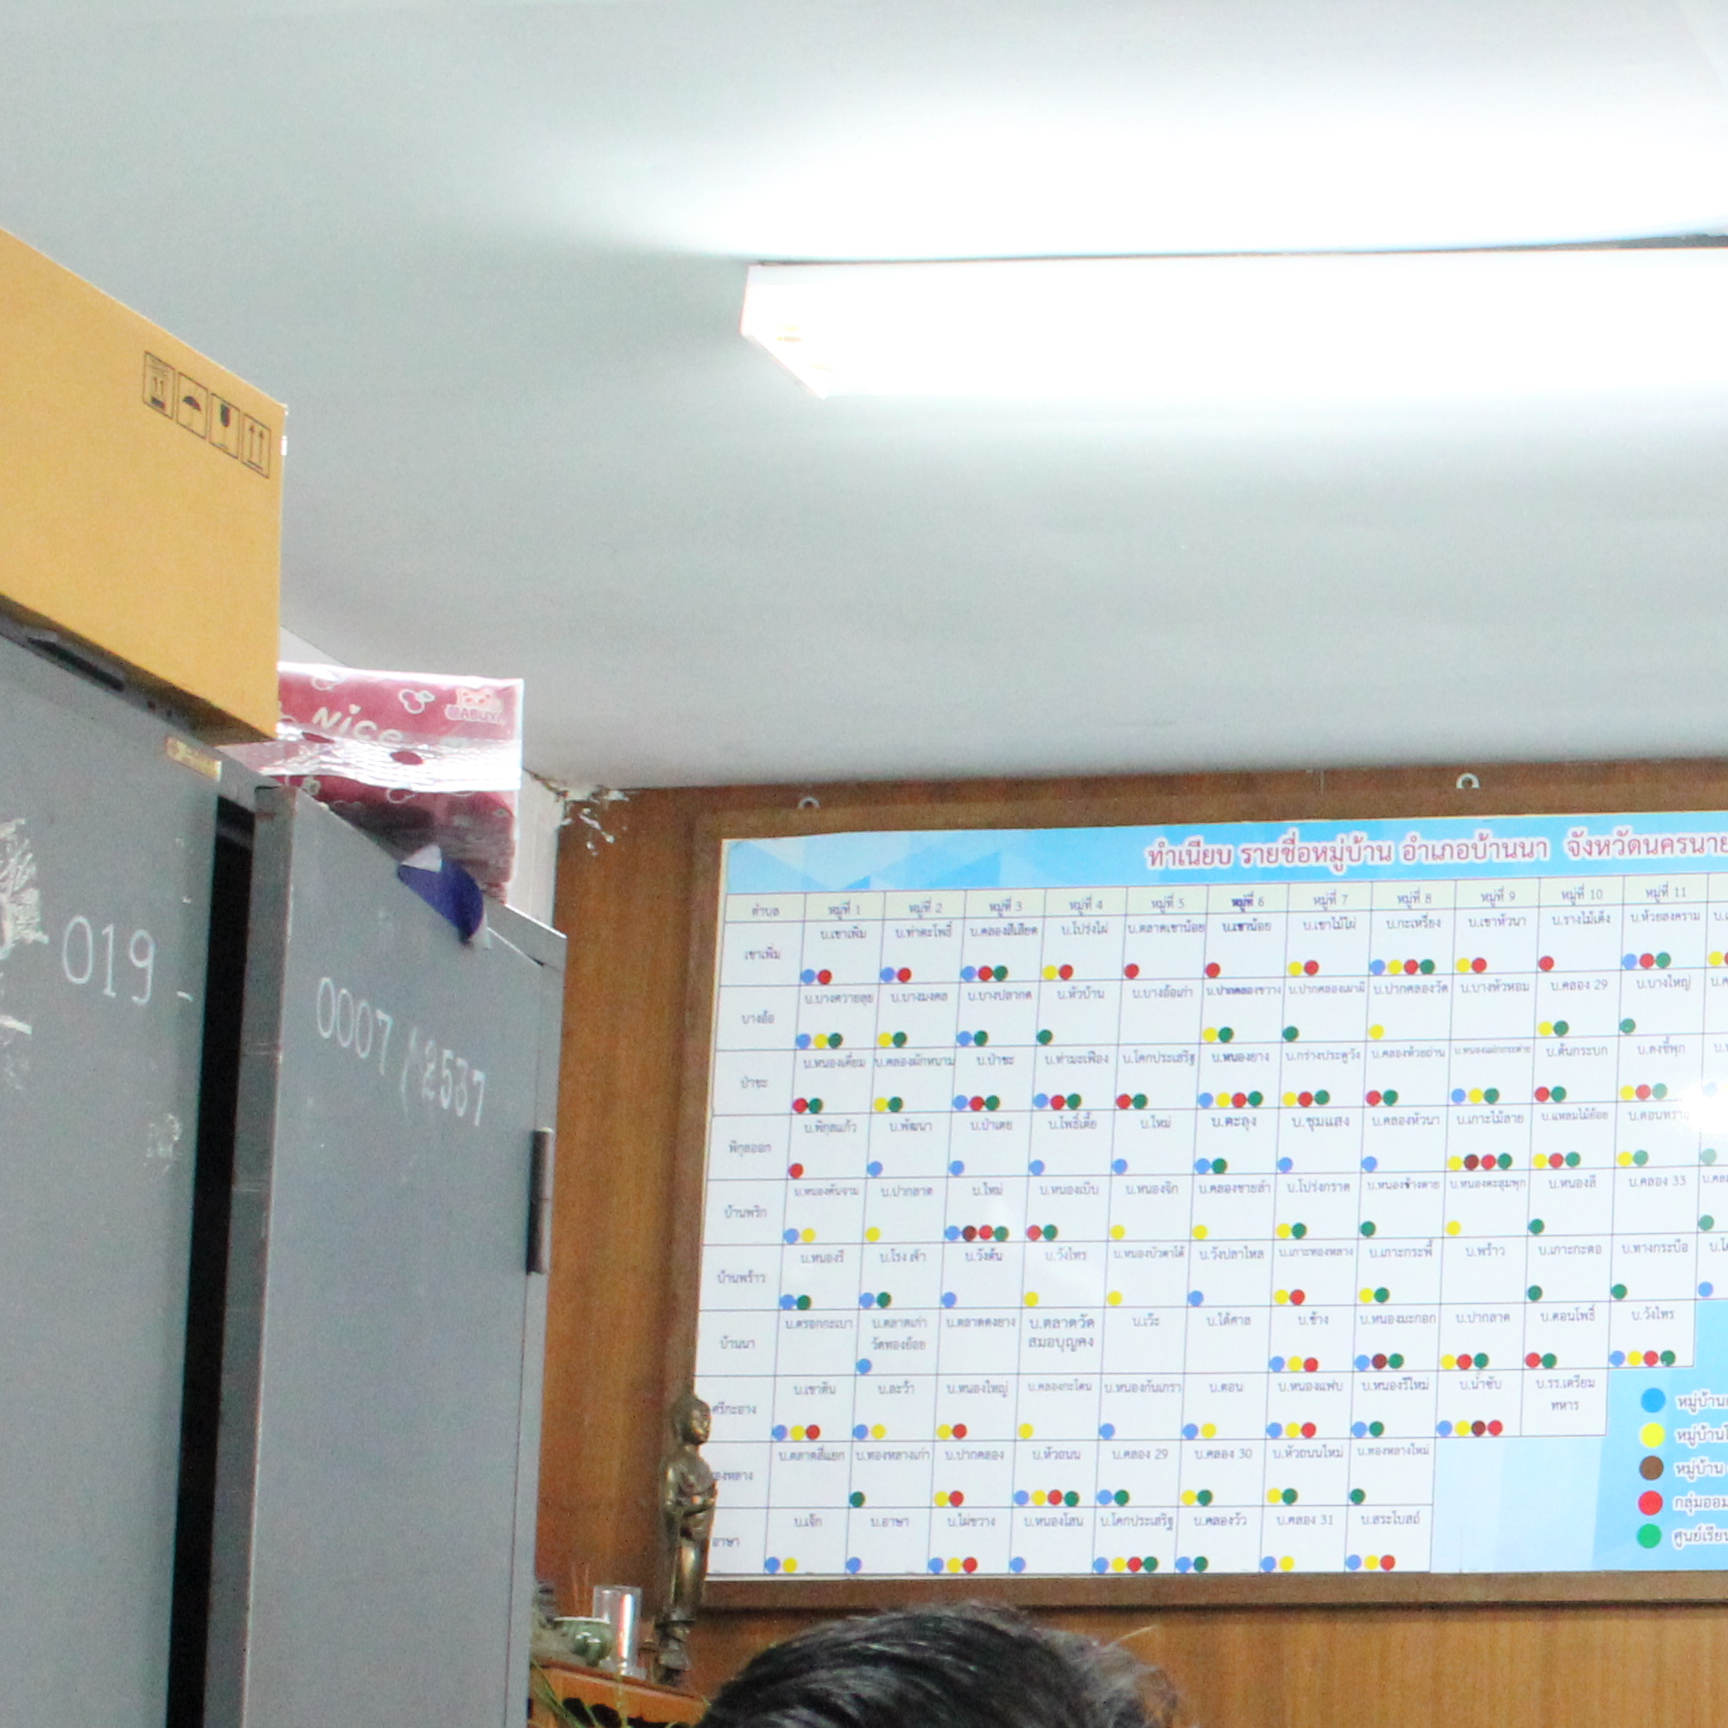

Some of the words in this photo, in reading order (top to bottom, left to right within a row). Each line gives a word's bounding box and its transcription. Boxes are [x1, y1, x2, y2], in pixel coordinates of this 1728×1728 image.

[1148, 843, 1231, 868] ทำเนียบ
[1240, 833, 1391, 872] รายชื่อหมู่บ้าน
[1403, 833, 1548, 860] อำเภอบ้านนา
[1424, 892, 1432, 904] 8
[1508, 890, 1516, 901] 9
[1590, 888, 1604, 901] 10
[1674, 886, 1687, 898] 11
[1096, 900, 1104, 910] 4
[1178, 897, 1185, 909] 5
[1257, 896, 1265, 908] 6
[1341, 893, 1349, 905] 7
[855, 904, 861, 915] 1
[1593, 978, 1609, 992] 29
[316, 976, 394, 1075] 0007
[1673, 1174, 1687, 1187] 33
[1673, 1456, 1725, 1482] หมู่บ้าน
